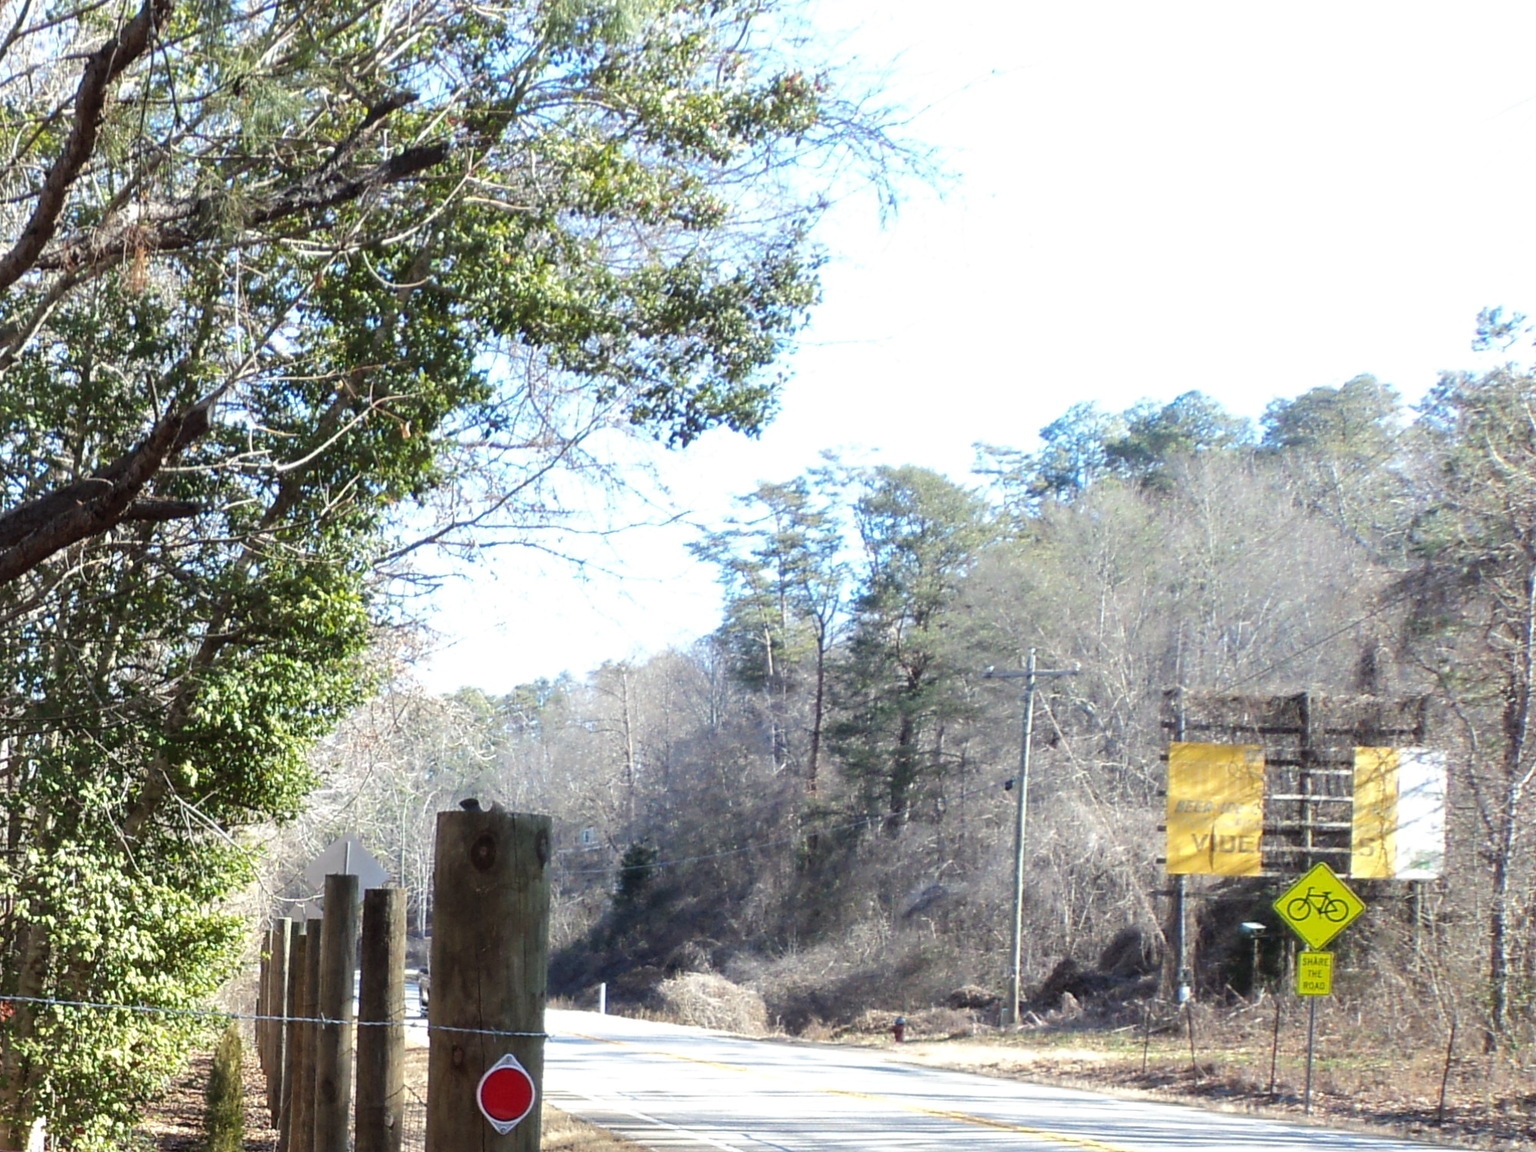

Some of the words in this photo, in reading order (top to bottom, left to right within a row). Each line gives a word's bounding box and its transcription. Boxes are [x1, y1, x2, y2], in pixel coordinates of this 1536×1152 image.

[1302, 957, 1330, 967] SHARE
[1307, 969, 1323, 978] THE
[1303, 981, 1326, 990] ROAD
